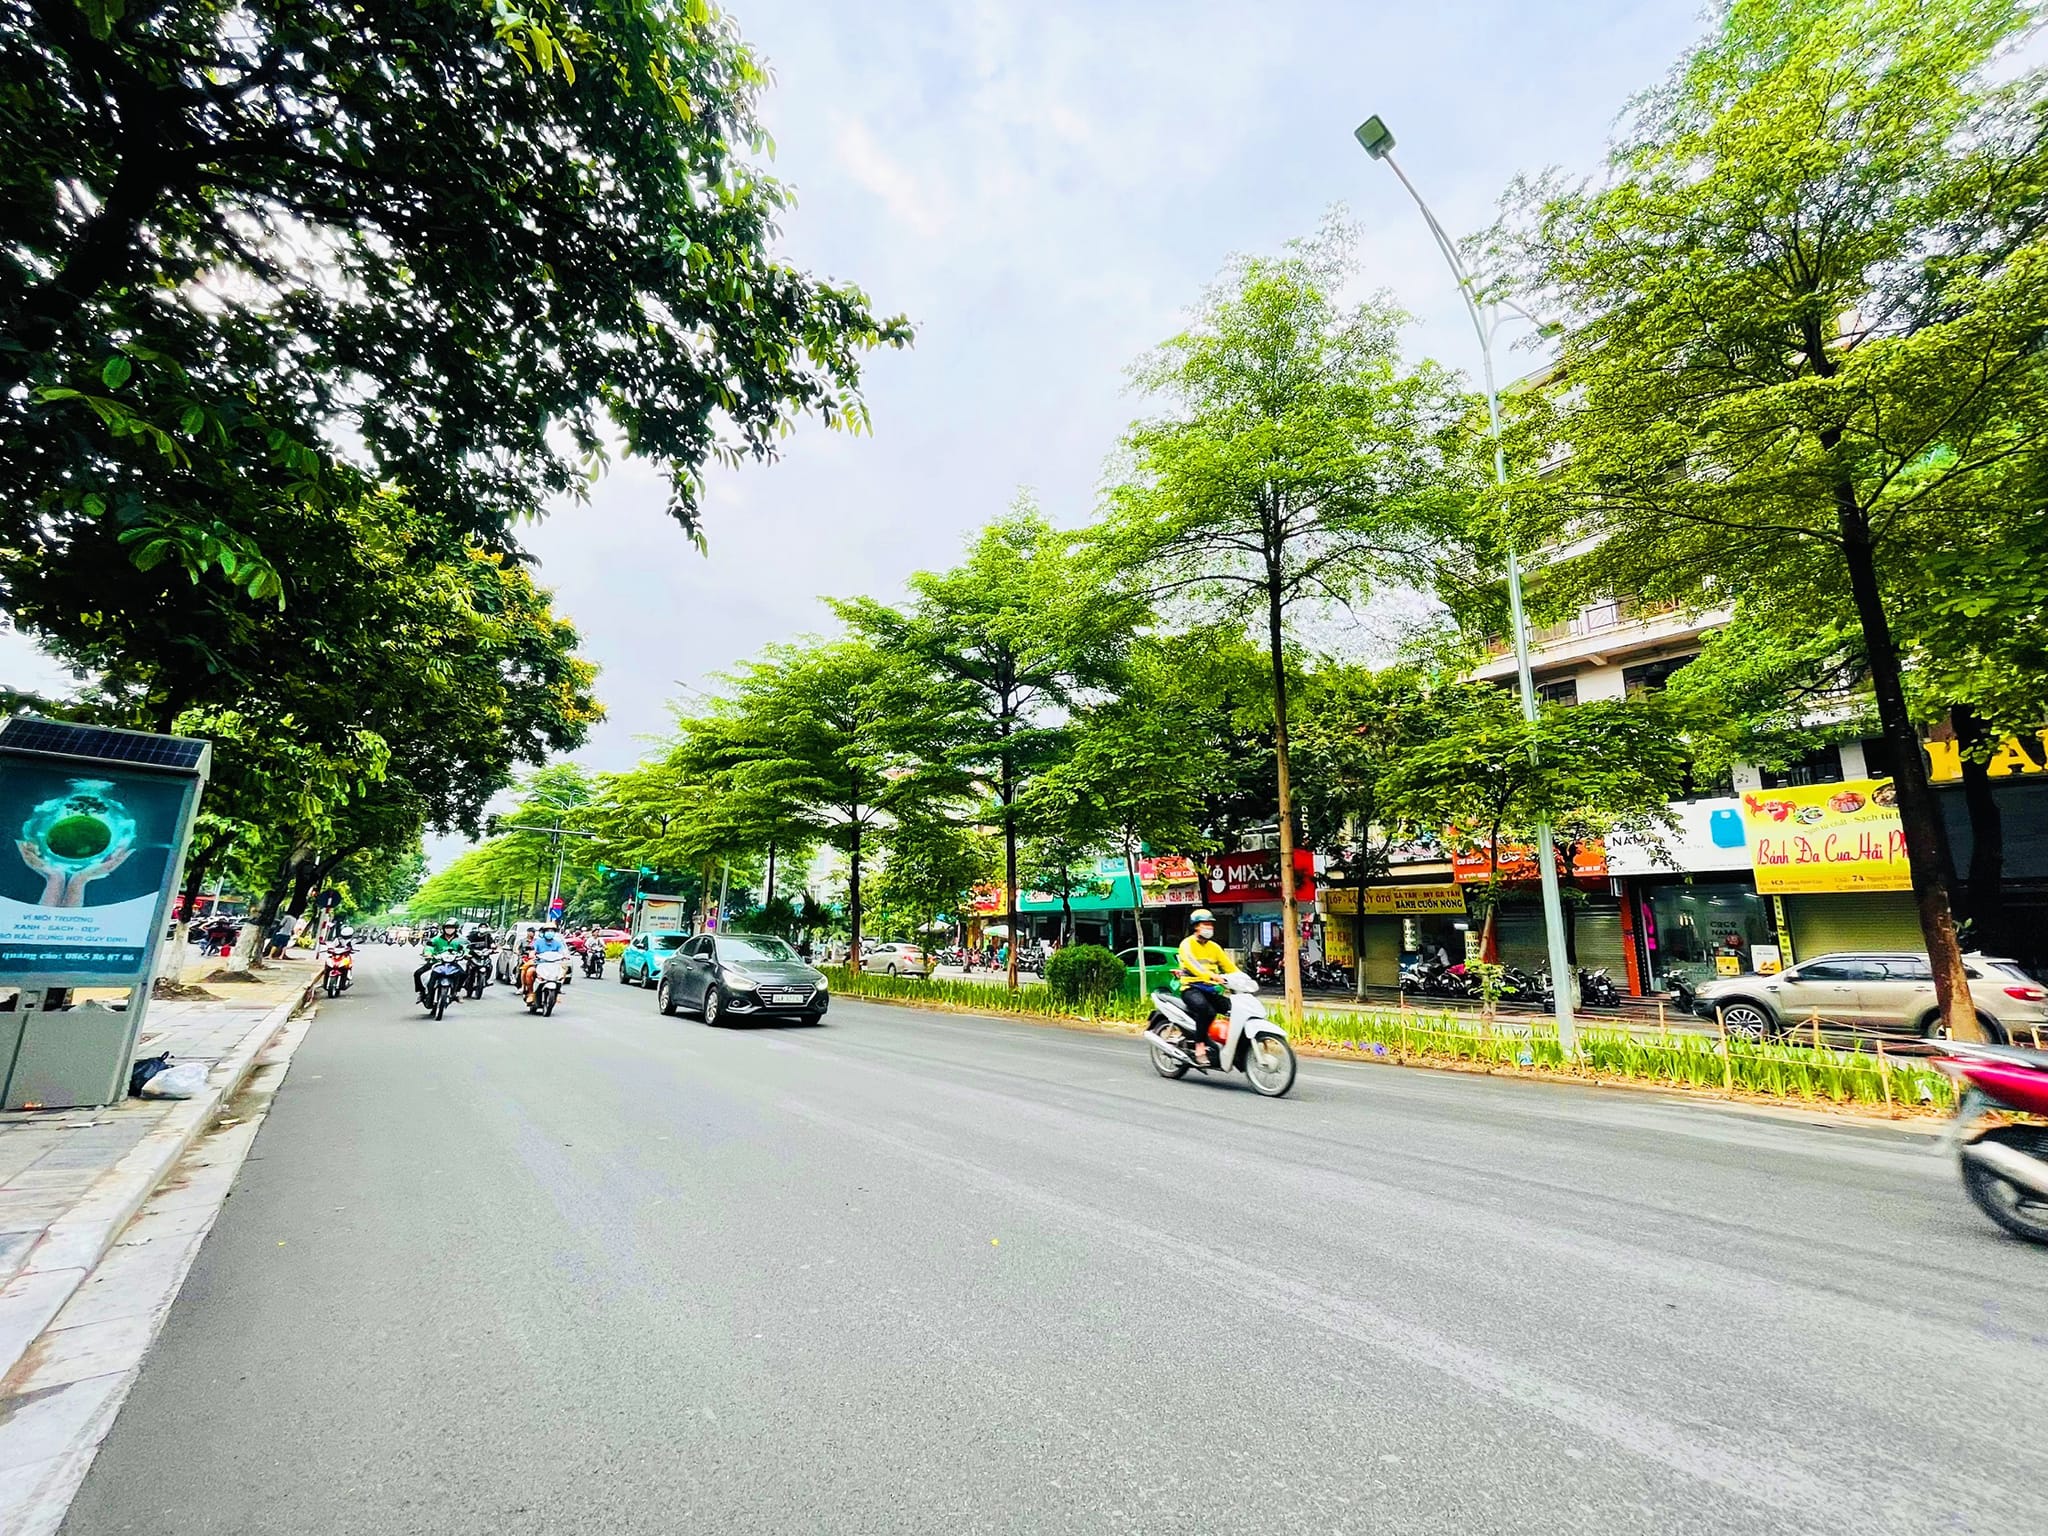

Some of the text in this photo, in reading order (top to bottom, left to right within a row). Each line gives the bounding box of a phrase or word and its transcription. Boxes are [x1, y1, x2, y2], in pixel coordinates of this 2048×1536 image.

[1757, 829, 1910, 865] Bánh Đa Cua Hải Ph
